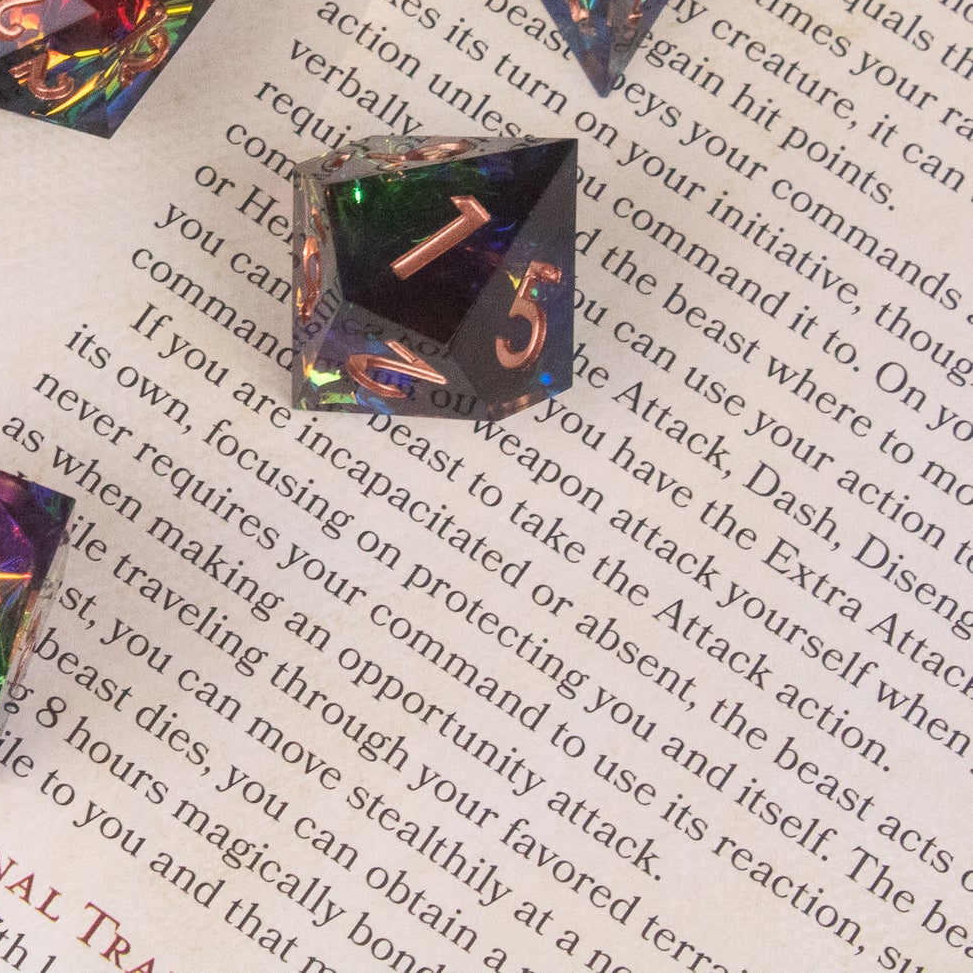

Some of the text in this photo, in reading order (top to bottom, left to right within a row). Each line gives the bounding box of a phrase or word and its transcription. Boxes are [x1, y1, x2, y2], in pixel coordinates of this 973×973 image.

[492, 52, 568, 117] turn
[614, 139, 707, 202] your
[704, 189, 861, 316] initiative,
[727, 81, 895, 212] hit points.
[390, 195, 492, 281] 1
[611, 195, 791, 320] command
[770, 177, 963, 311] commands
[495, 260, 563, 370] 5
[31, 372, 281, 551] never requires
[609, 379, 841, 552] Attack, Dash,
[714, 579, 880, 689] yourself
[759, 534, 863, 623] Extra
[200, 417, 915, 914] focusing itself. The
[336, 646, 547, 797] opportunity
[573, 613, 876, 822] absent, beast
[651, 597, 890, 773] Attack action.
[34, 694, 347, 928] 8 magically
[344, 784, 514, 908] stealthily
[498, 817, 642, 927] favored
